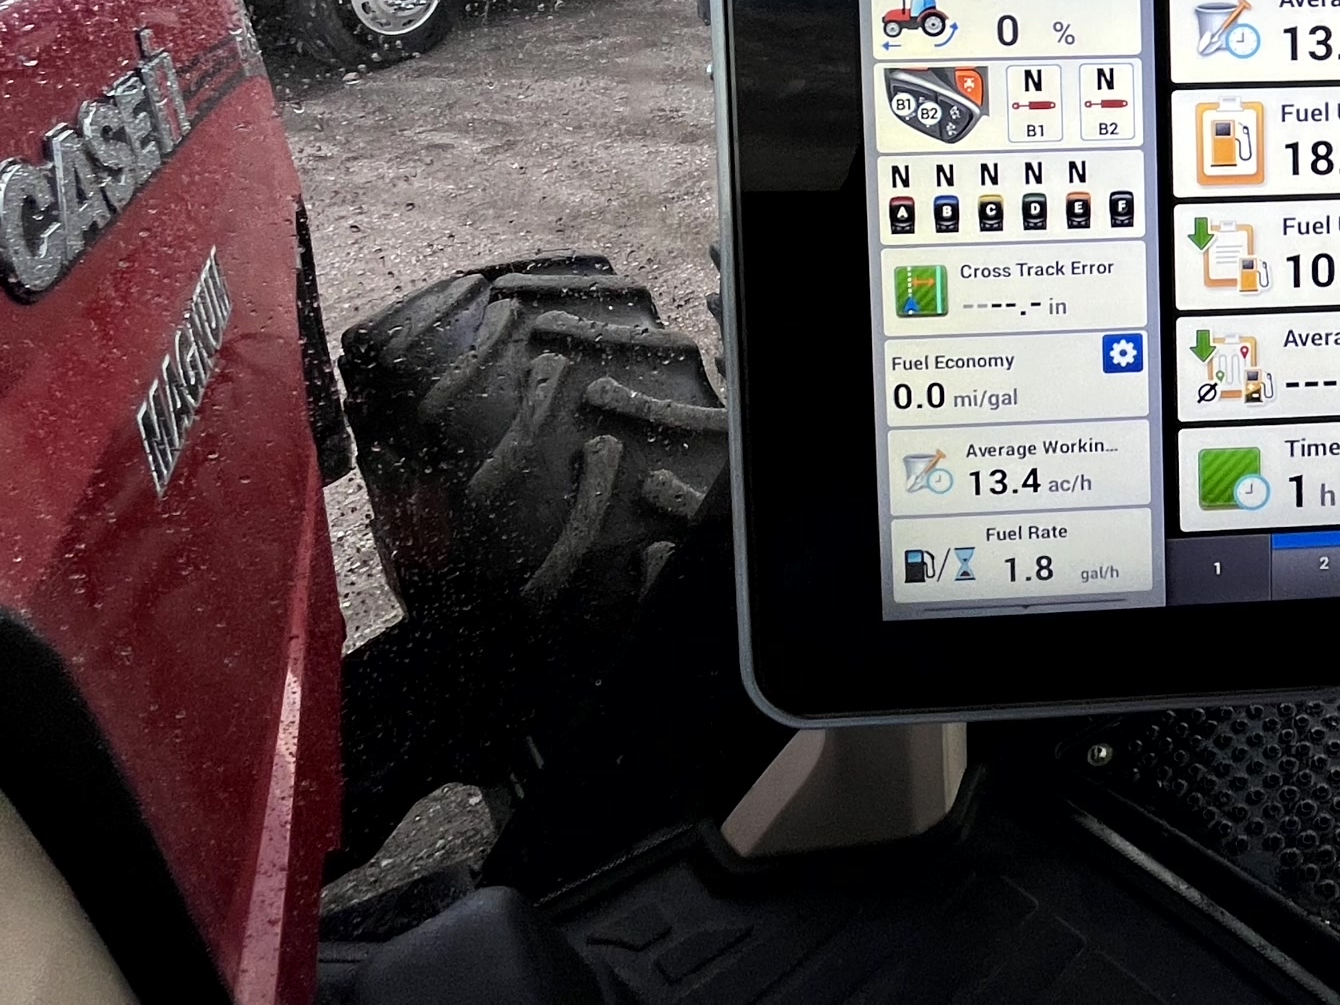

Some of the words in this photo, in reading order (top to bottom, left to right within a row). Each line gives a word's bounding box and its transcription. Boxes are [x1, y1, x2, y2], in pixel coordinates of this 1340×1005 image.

[997, 14, 1019, 46] 0
[1053, 21, 1076, 45] %
[1024, 69, 1043, 92] N
[1096, 68, 1115, 90] N
[896, 99, 911, 111] B1
[921, 108, 938, 120] B2
[1281, 103, 1329, 123] Fuel
[1027, 125, 1045, 137] B1
[1099, 123, 1119, 135] B2
[891, 165, 910, 188] N
[936, 164, 955, 187] N
[980, 163, 999, 186] N
[1024, 162, 1043, 185] N
[1068, 161, 1087, 184] N
[0, 69, 162, 296] CASE
[897, 206, 908, 218] A
[942, 205, 952, 217] B
[986, 204, 996, 216] C
[1030, 204, 1040, 215] D
[1074, 202, 1084, 213] E
[1118, 201, 1126, 212] F
[1282, 217, 1331, 236] Fuel
[960, 264, 1011, 279] Cross
[1016, 262, 1065, 277] Track
[1071, 261, 1114, 276] Error
[1049, 298, 1067, 315] in
[892, 356, 929, 371] Fuel
[935, 354, 1014, 371] Economy
[893, 382, 945, 410] 0.0
[953, 388, 1018, 410] mi/gal
[966, 443, 1037, 459] Average
[1043, 438, 1118, 454] Workin...
[1285, 438, 1340, 458] Time
[969, 468, 1041, 496] 13.4
[1048, 474, 1092, 492] ac/h
[1288, 474, 1304, 508] 1
[1321, 483, 1336, 506] h
[986, 526, 1022, 542] Fuel
[1028, 526, 1068, 540] Rate
[1004, 555, 1054, 583] 1.8
[1081, 566, 1119, 583] gal/h
[1213, 562, 1222, 576] 1
[1319, 556, 1329, 570] 2
